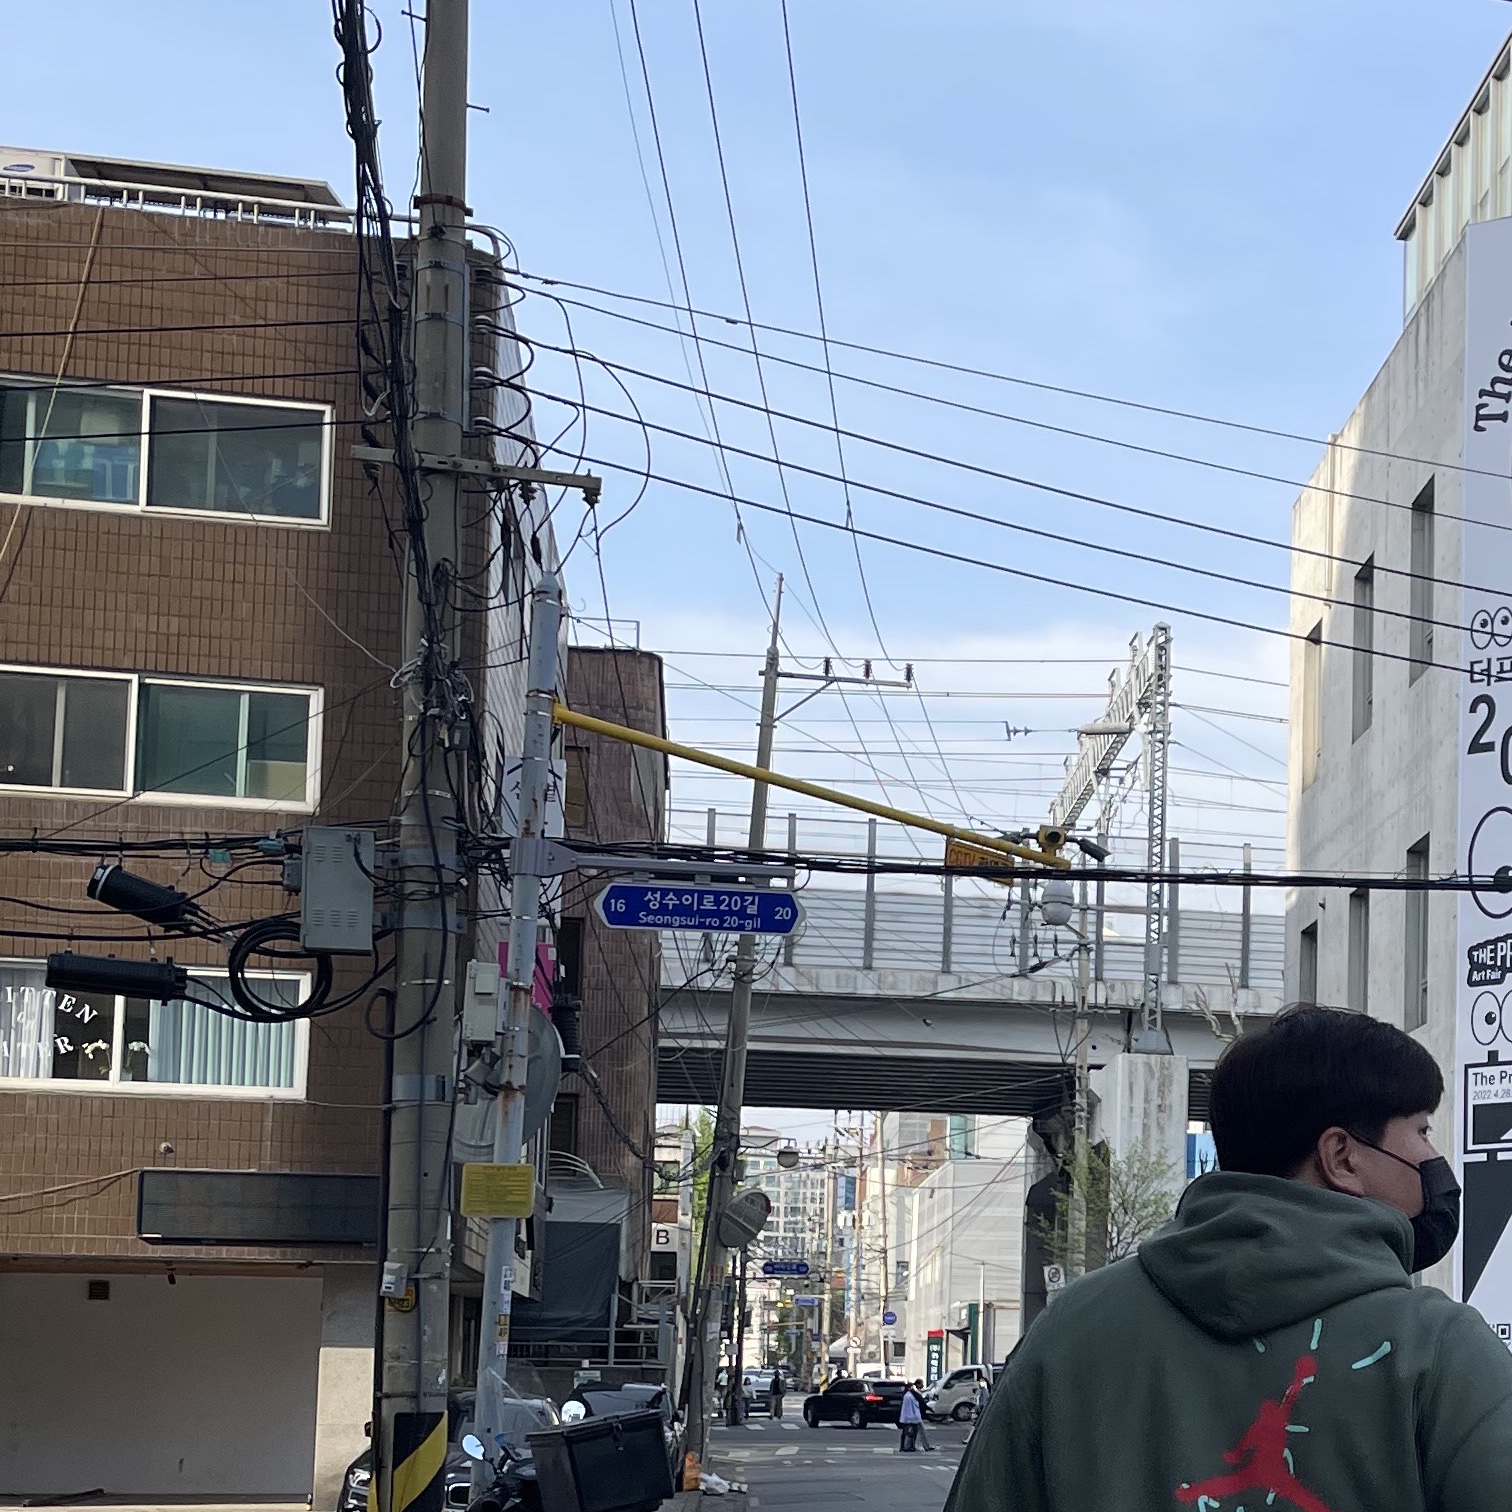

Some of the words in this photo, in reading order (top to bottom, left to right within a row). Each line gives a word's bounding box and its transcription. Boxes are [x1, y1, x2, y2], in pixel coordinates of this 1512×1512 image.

[609, 898, 626, 912] 16
[643, 890, 759, 915] 성수이로20길
[773, 906, 792, 920] 20
[638, 911, 720, 927] Seongsui-ro
[723, 915, 761, 931] 20-gil
[1472, 944, 1495, 965] THE
[1472, 970, 1485, 981] Art
[1486, 967, 1502, 981] Fair
[1472, 1072, 1496, 1087] The
[656, 1230, 669, 1244] B
